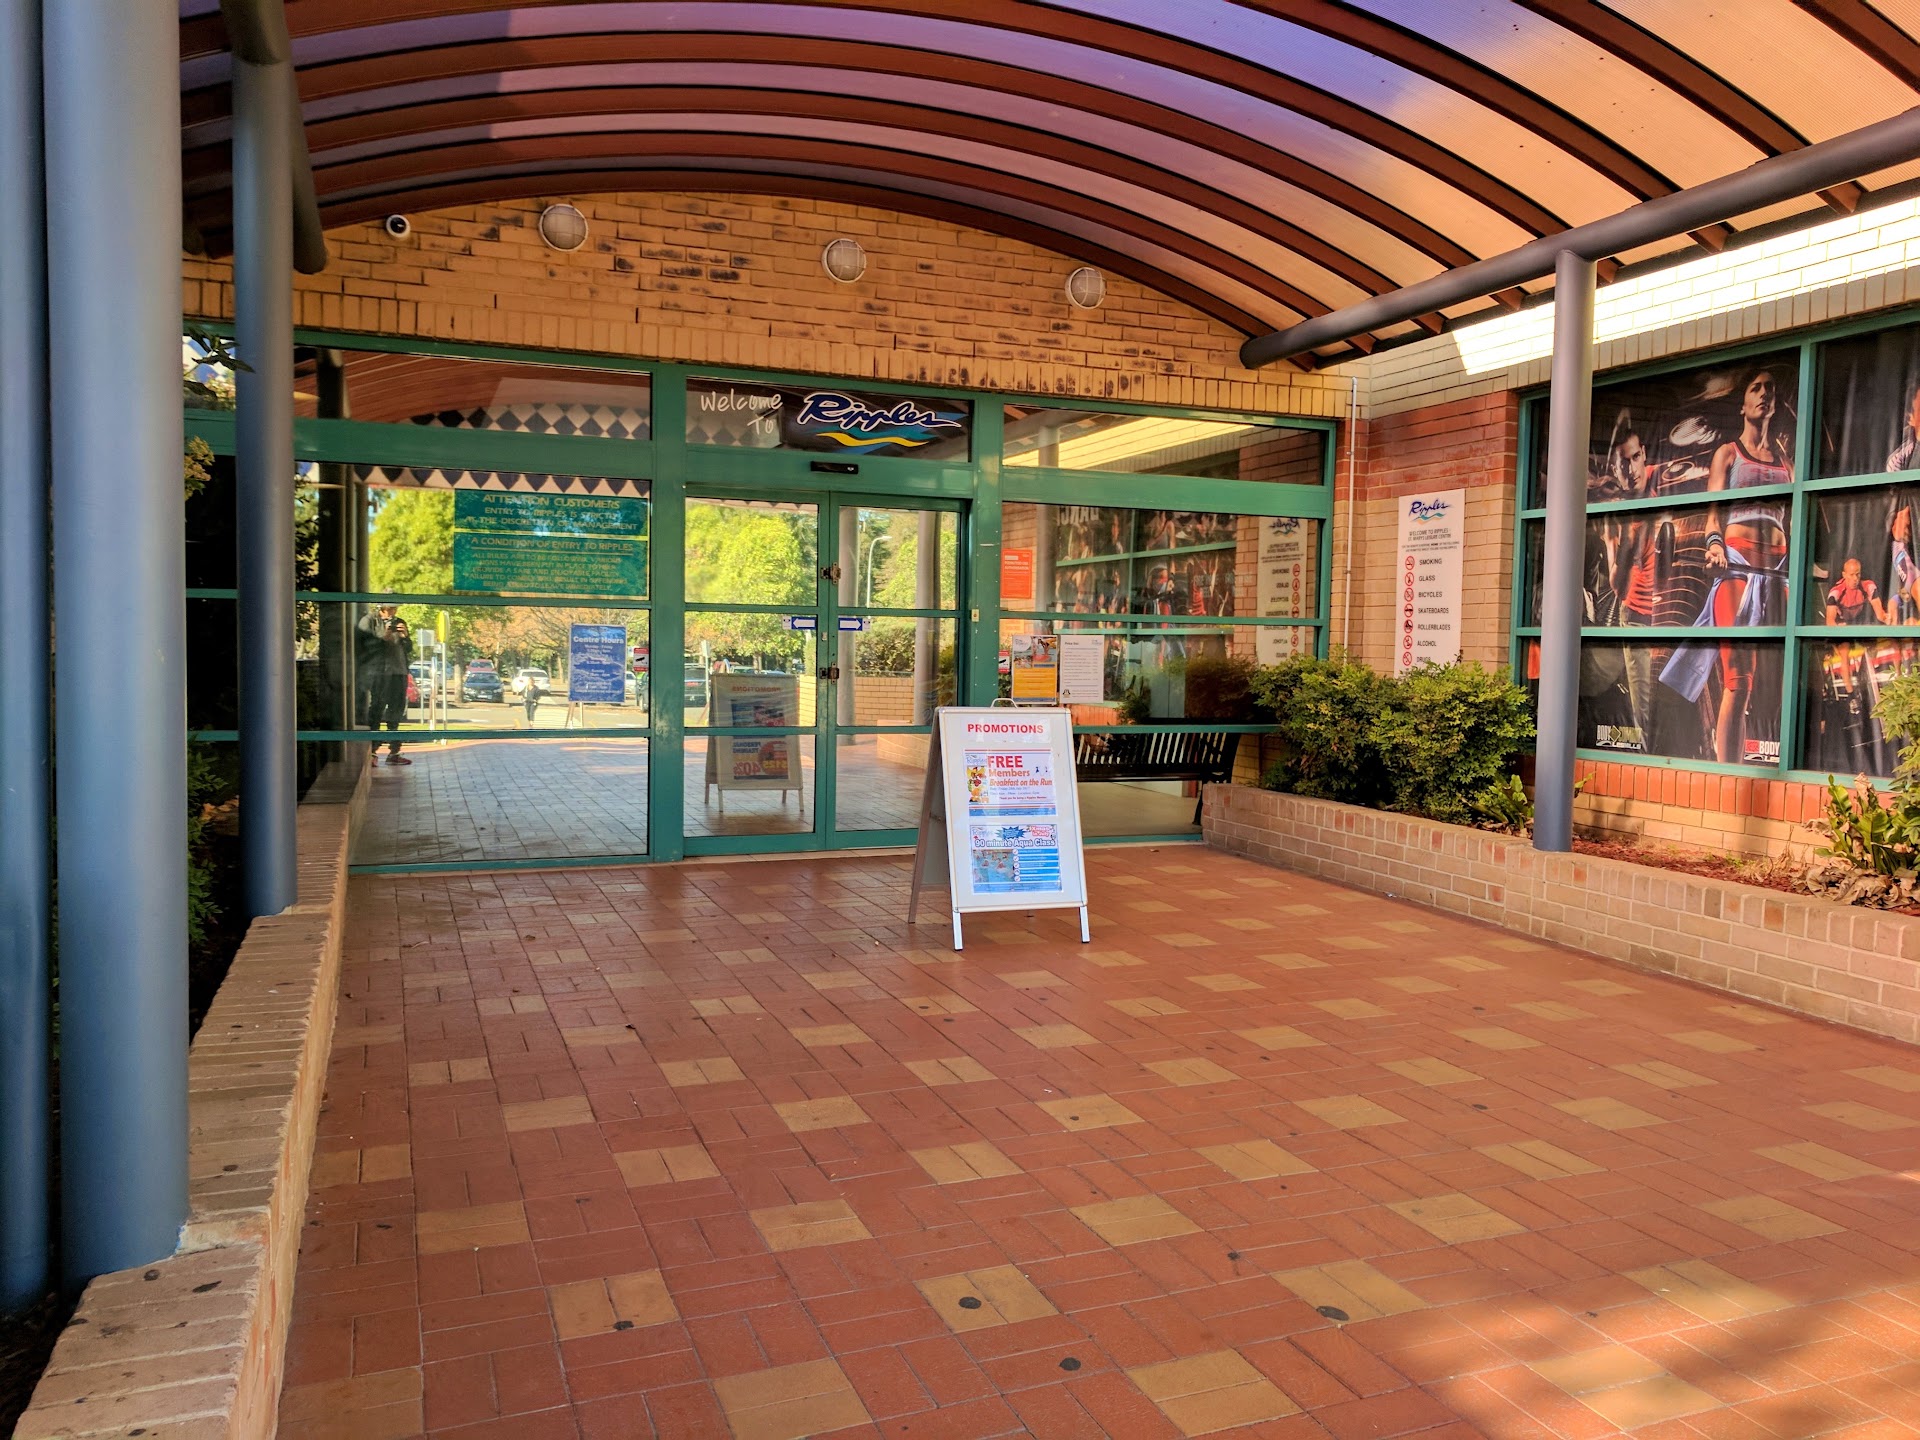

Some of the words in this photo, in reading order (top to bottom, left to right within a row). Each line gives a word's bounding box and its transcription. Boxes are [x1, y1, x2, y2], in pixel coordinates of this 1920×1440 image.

[701, 388, 784, 413] Welcome
[797, 392, 962, 432] Ripples
[747, 415, 774, 435] To
[482, 494, 550, 506] ATTENTION
[554, 498, 620, 509] CUSTOMERS
[1409, 499, 1452, 517] Ripples
[484, 507, 515, 515] ENTRY
[533, 509, 567, 518] RIPPLES
[580, 512, 618, 520] STRICTLY
[479, 516, 498, 525] THE
[501, 517, 554, 526] DISCRETION
[573, 521, 638, 530] MANAGEMENT
[481, 537, 535, 547] CONDITION
[536, 540, 550, 548] OF
[551, 541, 581, 550] ENTRY
[584, 542, 597, 550] TO
[599, 543, 633, 551] RIPPLES
[1419, 558, 1442, 566] SMOKING
[967, 723, 1044, 734] PROMOTIONS
[987, 755, 1024, 768] FREE
[988, 768, 1031, 778] Members
[989, 778, 1021, 787] Breakfast
[1029, 778, 1039, 786] the
[1040, 777, 1053, 786] Run
[975, 839, 985, 848] 90
[986, 839, 1013, 847] minute
[1013, 839, 1033, 848] Aqua
[1034, 838, 1056, 847] Class
